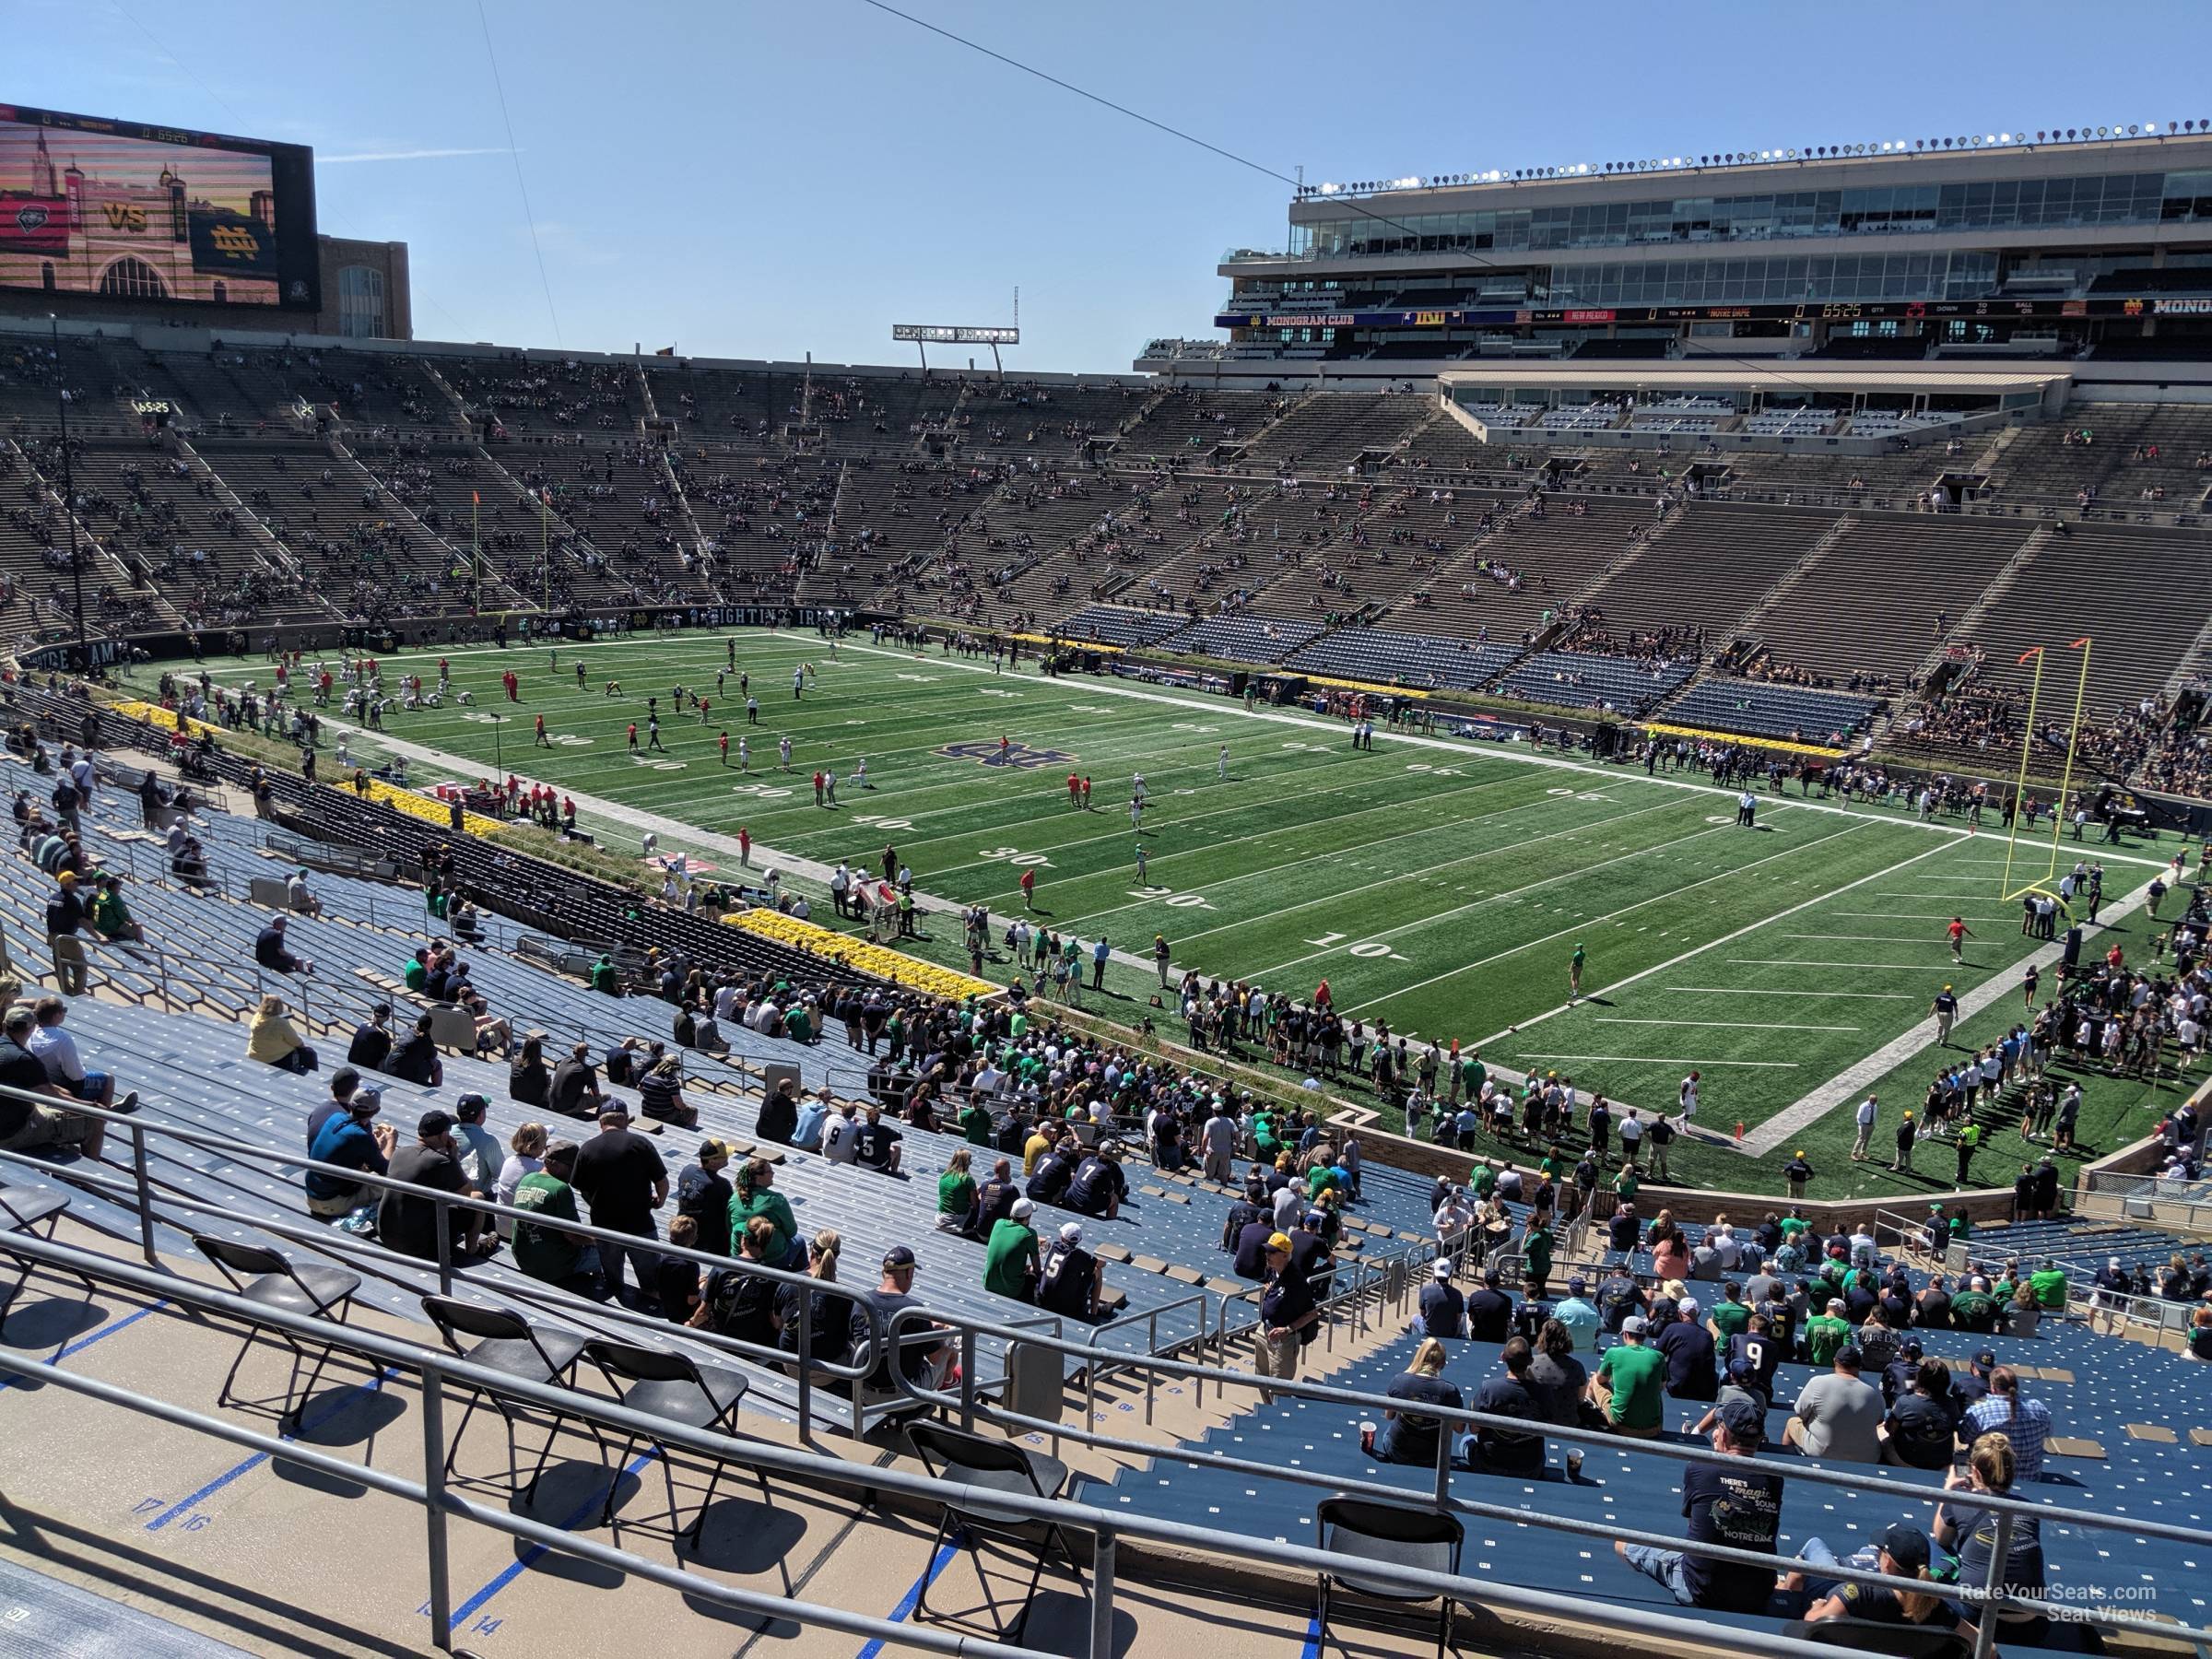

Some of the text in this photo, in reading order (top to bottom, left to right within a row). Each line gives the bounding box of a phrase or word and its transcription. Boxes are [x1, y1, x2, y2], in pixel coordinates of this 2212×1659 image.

[102, 201, 147, 232] VS
[1648, 308, 1657, 320] 0
[1710, 307, 1750, 318] NOTRE DAME
[1794, 305, 1805, 318] 0
[1822, 303, 1862, 318] 65:25
[2153, 300, 2212, 314] MONO
[1266, 314, 1355, 326] MONOGRAM CLUB
[1571, 311, 1608, 320] NEW MEXICO
[301, 406, 313, 416] 25
[733, 783, 793, 798] 50
[850, 815, 912, 830] 40
[979, 847, 1048, 865] 30
[1125, 887, 1206, 907] 20
[1303, 931, 1393, 957] 10
[1182, 1101, 1194, 1113] 88
[830, 1126, 841, 1146] 9
[863, 1135, 875, 1157] 5
[1037, 1158, 1053, 1175] 7
[1081, 1164, 1096, 1182] 7
[1046, 1253, 1065, 1278] 5
[1529, 1317, 1537, 1335] 1
[1747, 1343, 1762, 1370] 9
[1167, 1386, 1184, 1394] 47
[1118, 1402, 1135, 1413] 49
[1024, 1432, 1045, 1444] 52
[1720, 1477, 1748, 1488] THERE'S
[133, 1498, 164, 1512] 17
[179, 1514, 211, 1531] 16
[1724, 1531, 1773, 1543] NOTRE DAME
[7, 1609, 26, 1619] 16
[471, 1615, 503, 1636] 14
